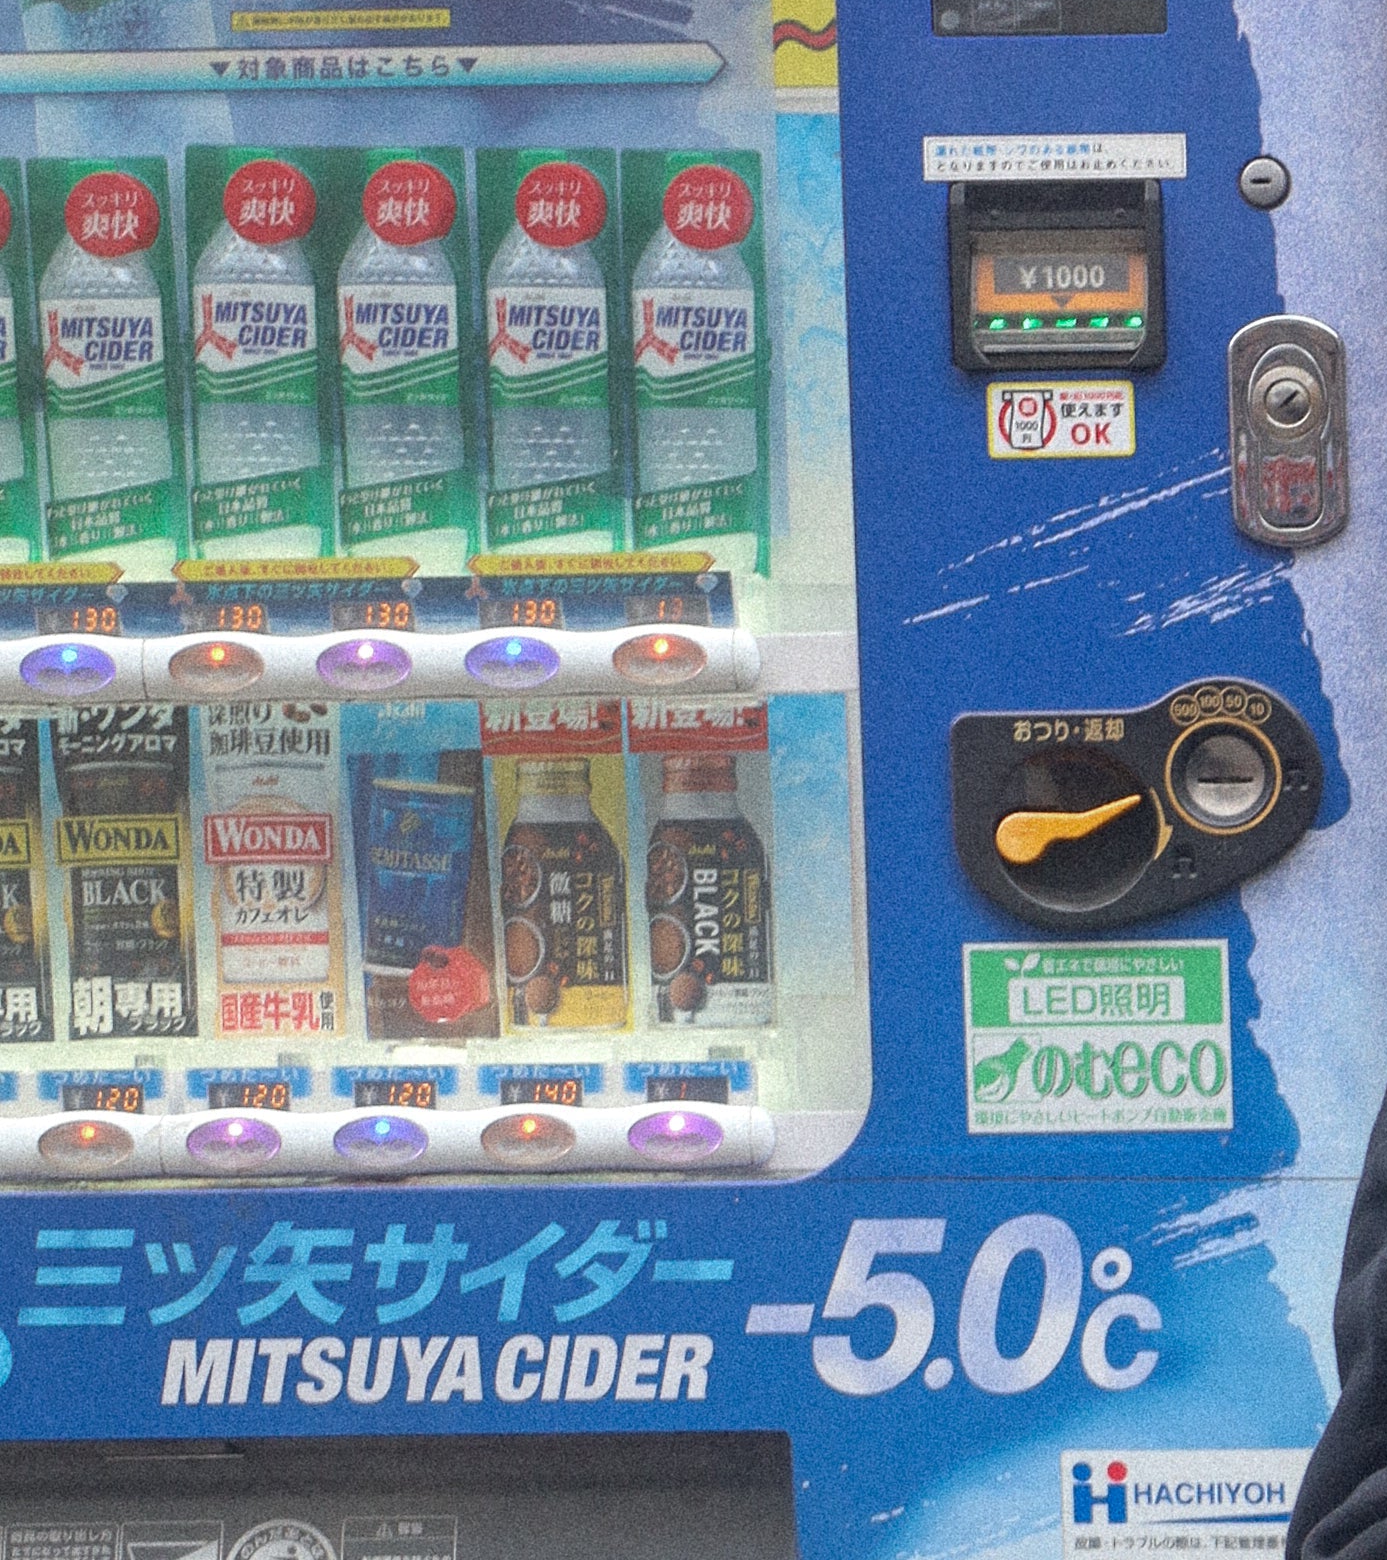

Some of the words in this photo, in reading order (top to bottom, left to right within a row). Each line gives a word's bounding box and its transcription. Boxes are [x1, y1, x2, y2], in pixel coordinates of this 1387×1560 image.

[236, 54, 459, 82] 対象商品はこちら
[81, 209, 141, 241] 爽快
[239, 194, 296, 226] 爽快
[373, 194, 430, 228] 爽快
[527, 196, 583, 230] 爽快
[675, 198, 731, 231] 爽快
[1020, 264, 1106, 290] ¥1000
[60, 314, 154, 340] MITSUYA
[213, 300, 309, 327] MITSUYA
[355, 302, 450, 330] MITSUYA
[83, 338, 154, 364] CIDER
[237, 324, 310, 350] CIDER
[377, 326, 451, 352] CIDER
[1061, 401, 1125, 418] 使えます
[1070, 421, 1113, 446] OK
[1012, 719, 1126, 743] おつり・返却
[63, 819, 172, 852] WONDA
[213, 818, 322, 852] WONDA
[81, 880, 169, 906] BLACK
[233, 871, 309, 903] 特製
[234, 906, 310, 926] カフェオレ
[691, 867, 721, 958] BLACK
[72, 976, 183, 1035] 朝専用
[219, 991, 320, 1033] 国産牛乳
[1021, 984, 1172, 1018] LED照明
[1031, 1037, 1227, 1101] のむeco
[17, 1218, 735, 1328] 三ツ矢サイダー
[159, 1335, 487, 1408] MITSUYA
[494, 1333, 715, 1404] CIDER
[1133, 1481, 1286, 1507] HACHIYOH
